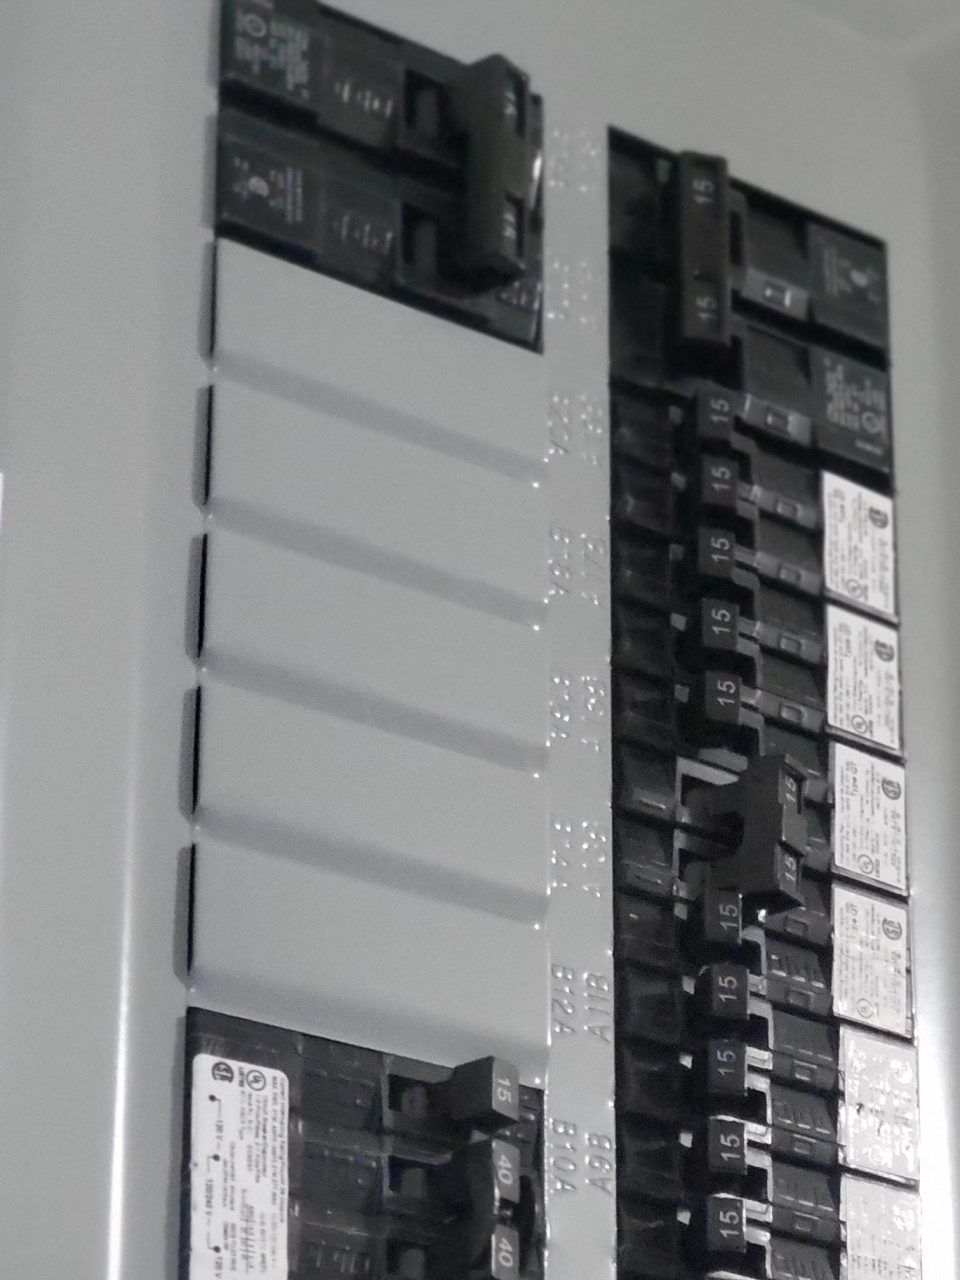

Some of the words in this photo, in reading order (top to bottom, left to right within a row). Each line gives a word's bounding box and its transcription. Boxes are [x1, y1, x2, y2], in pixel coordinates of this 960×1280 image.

[710, 397, 731, 423] 15
[711, 465, 732, 491] 15
[710, 536, 731, 564] 15
[711, 608, 732, 634] 15
[716, 679, 737, 706] 15
[785, 776, 798, 801] 15
[784, 855, 798, 882] 15
[719, 903, 739, 932] 15
[718, 975, 738, 1002] 15
[717, 1047, 736, 1076] 15
[496, 1077, 514, 1103] 15
[719, 1133, 741, 1161] 15
[497, 1152, 514, 1185] 40
[719, 1210, 740, 1238] 15
[497, 1236, 515, 1268] 40
